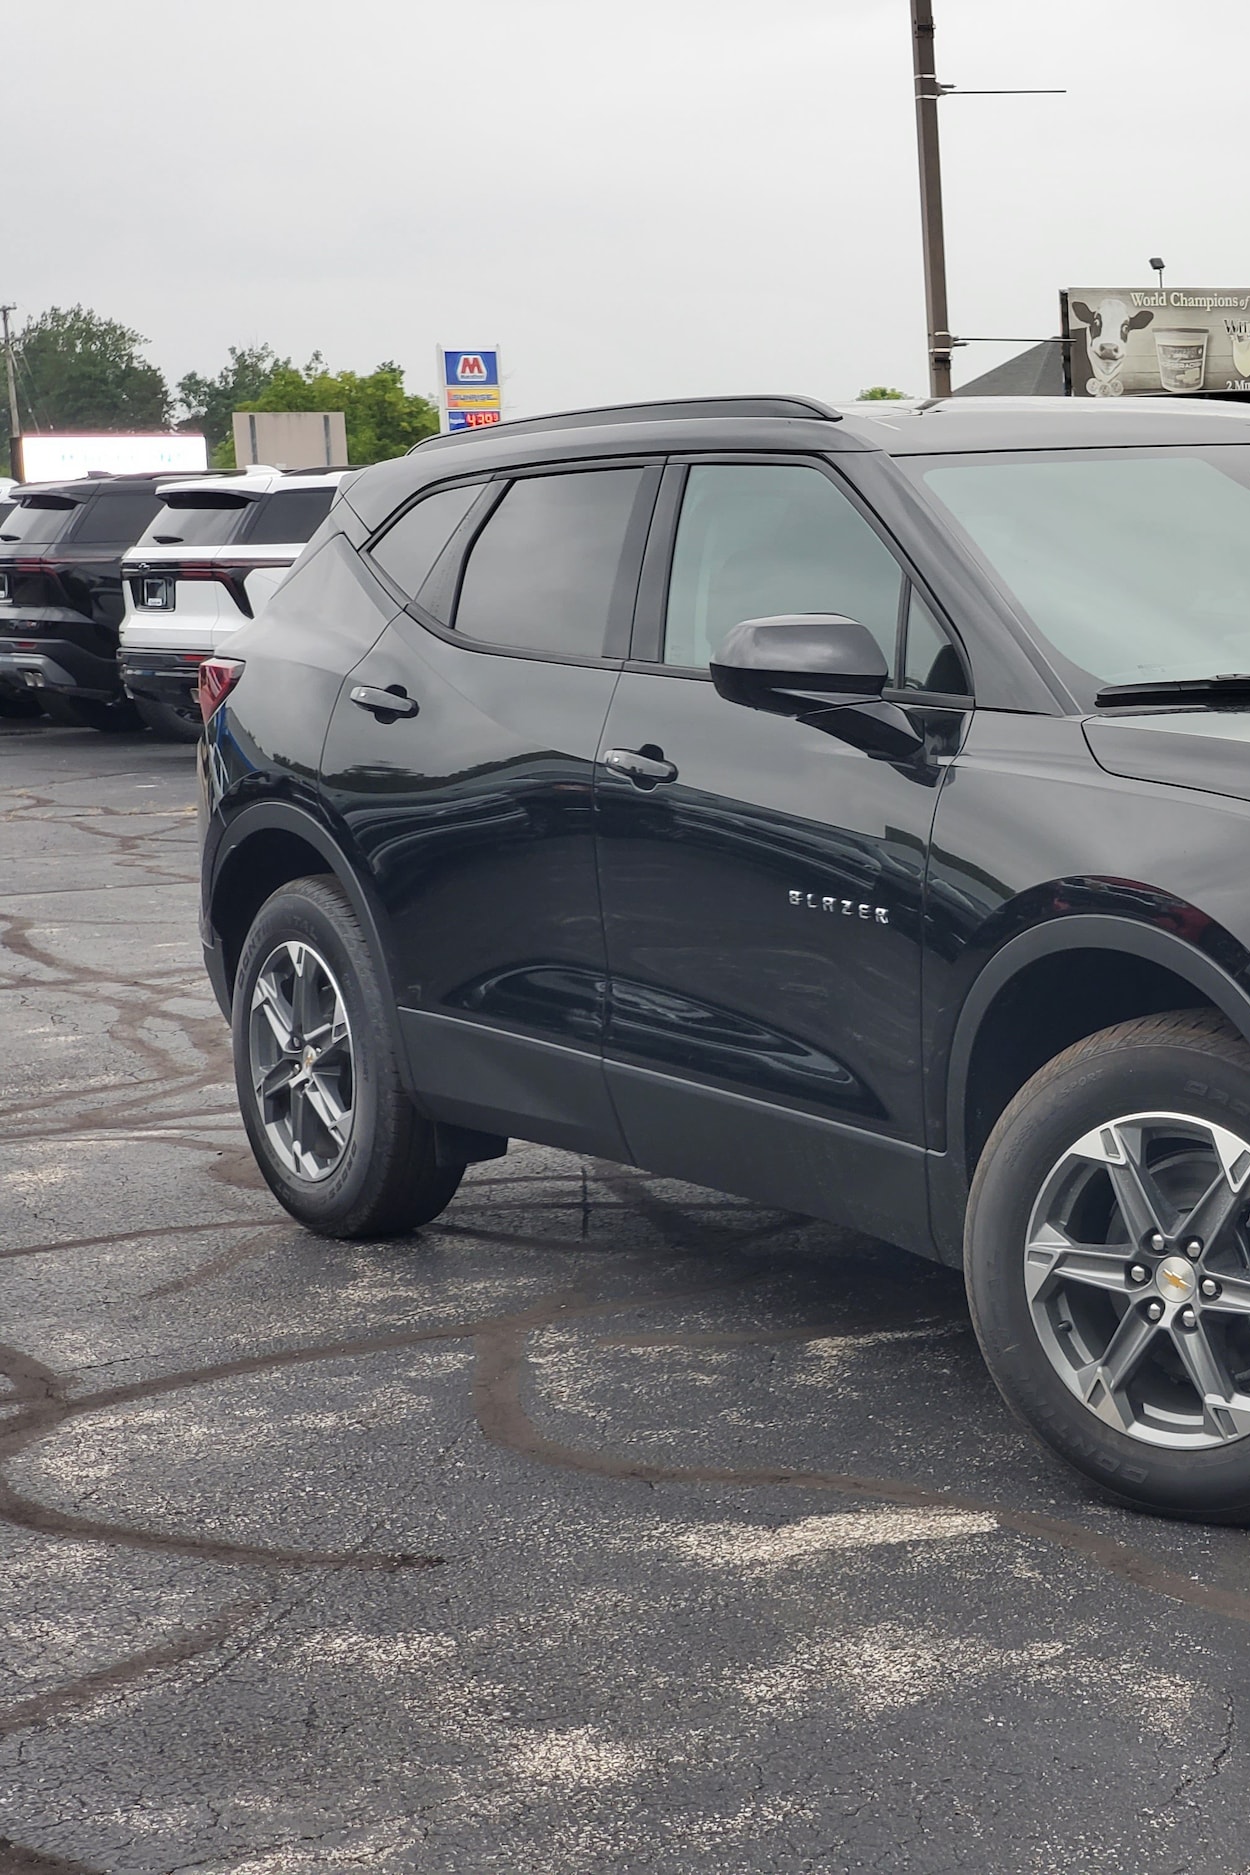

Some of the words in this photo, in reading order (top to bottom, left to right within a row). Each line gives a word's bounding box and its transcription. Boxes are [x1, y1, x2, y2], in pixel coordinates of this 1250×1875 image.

[1130, 292, 1167, 307] World
[1169, 292, 1239, 311] Champions
[1226, 380, 1233, 391] 2
[788, 889, 890, 924] BLAZER
